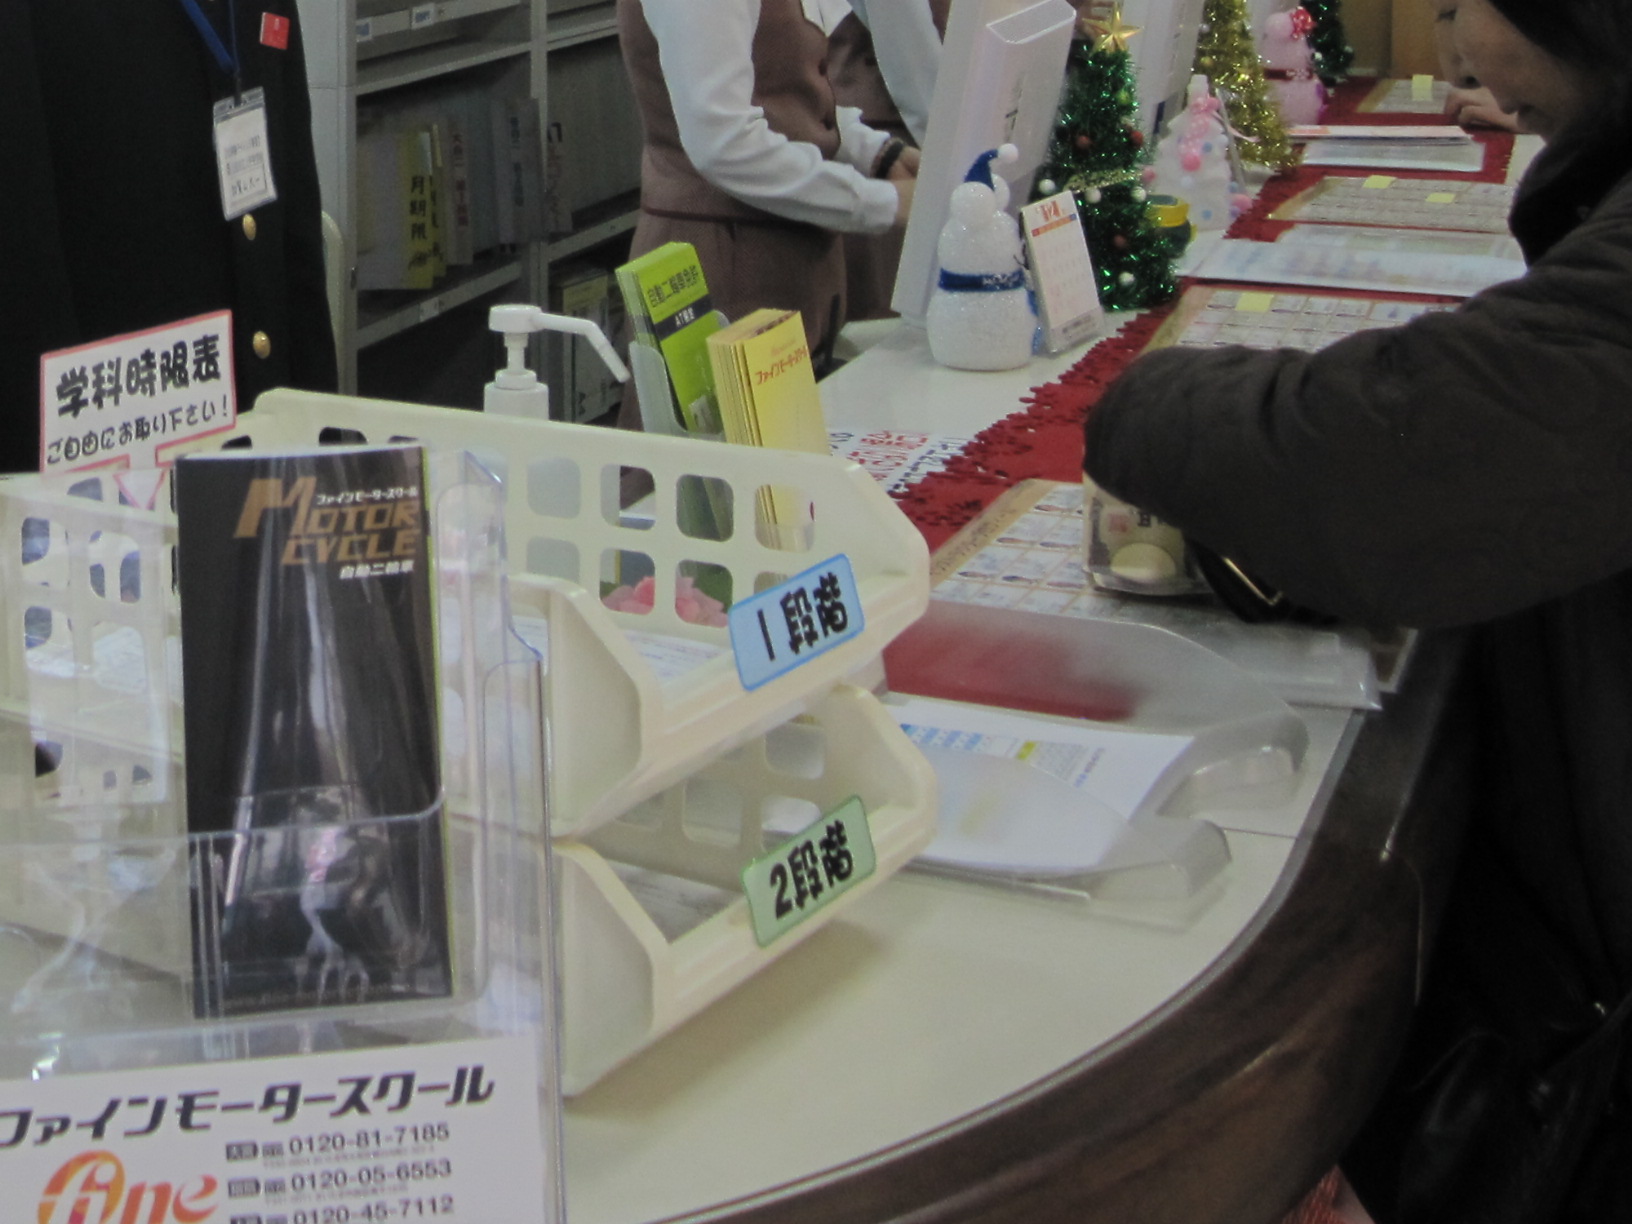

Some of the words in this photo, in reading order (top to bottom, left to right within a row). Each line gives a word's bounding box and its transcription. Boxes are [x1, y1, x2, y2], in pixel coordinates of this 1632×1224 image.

[56, 334, 221, 418] 学科時限表
[233, 476, 419, 539] MOTOR
[316, 486, 418, 506] ファインモータースクール
[280, 529, 421, 566] CYCLE
[288, 1122, 450, 1155] 0120-81-7185
[291, 1158, 452, 1191] 0120-05-6553
[293, 1194, 455, 1224] 0120-45-7112
